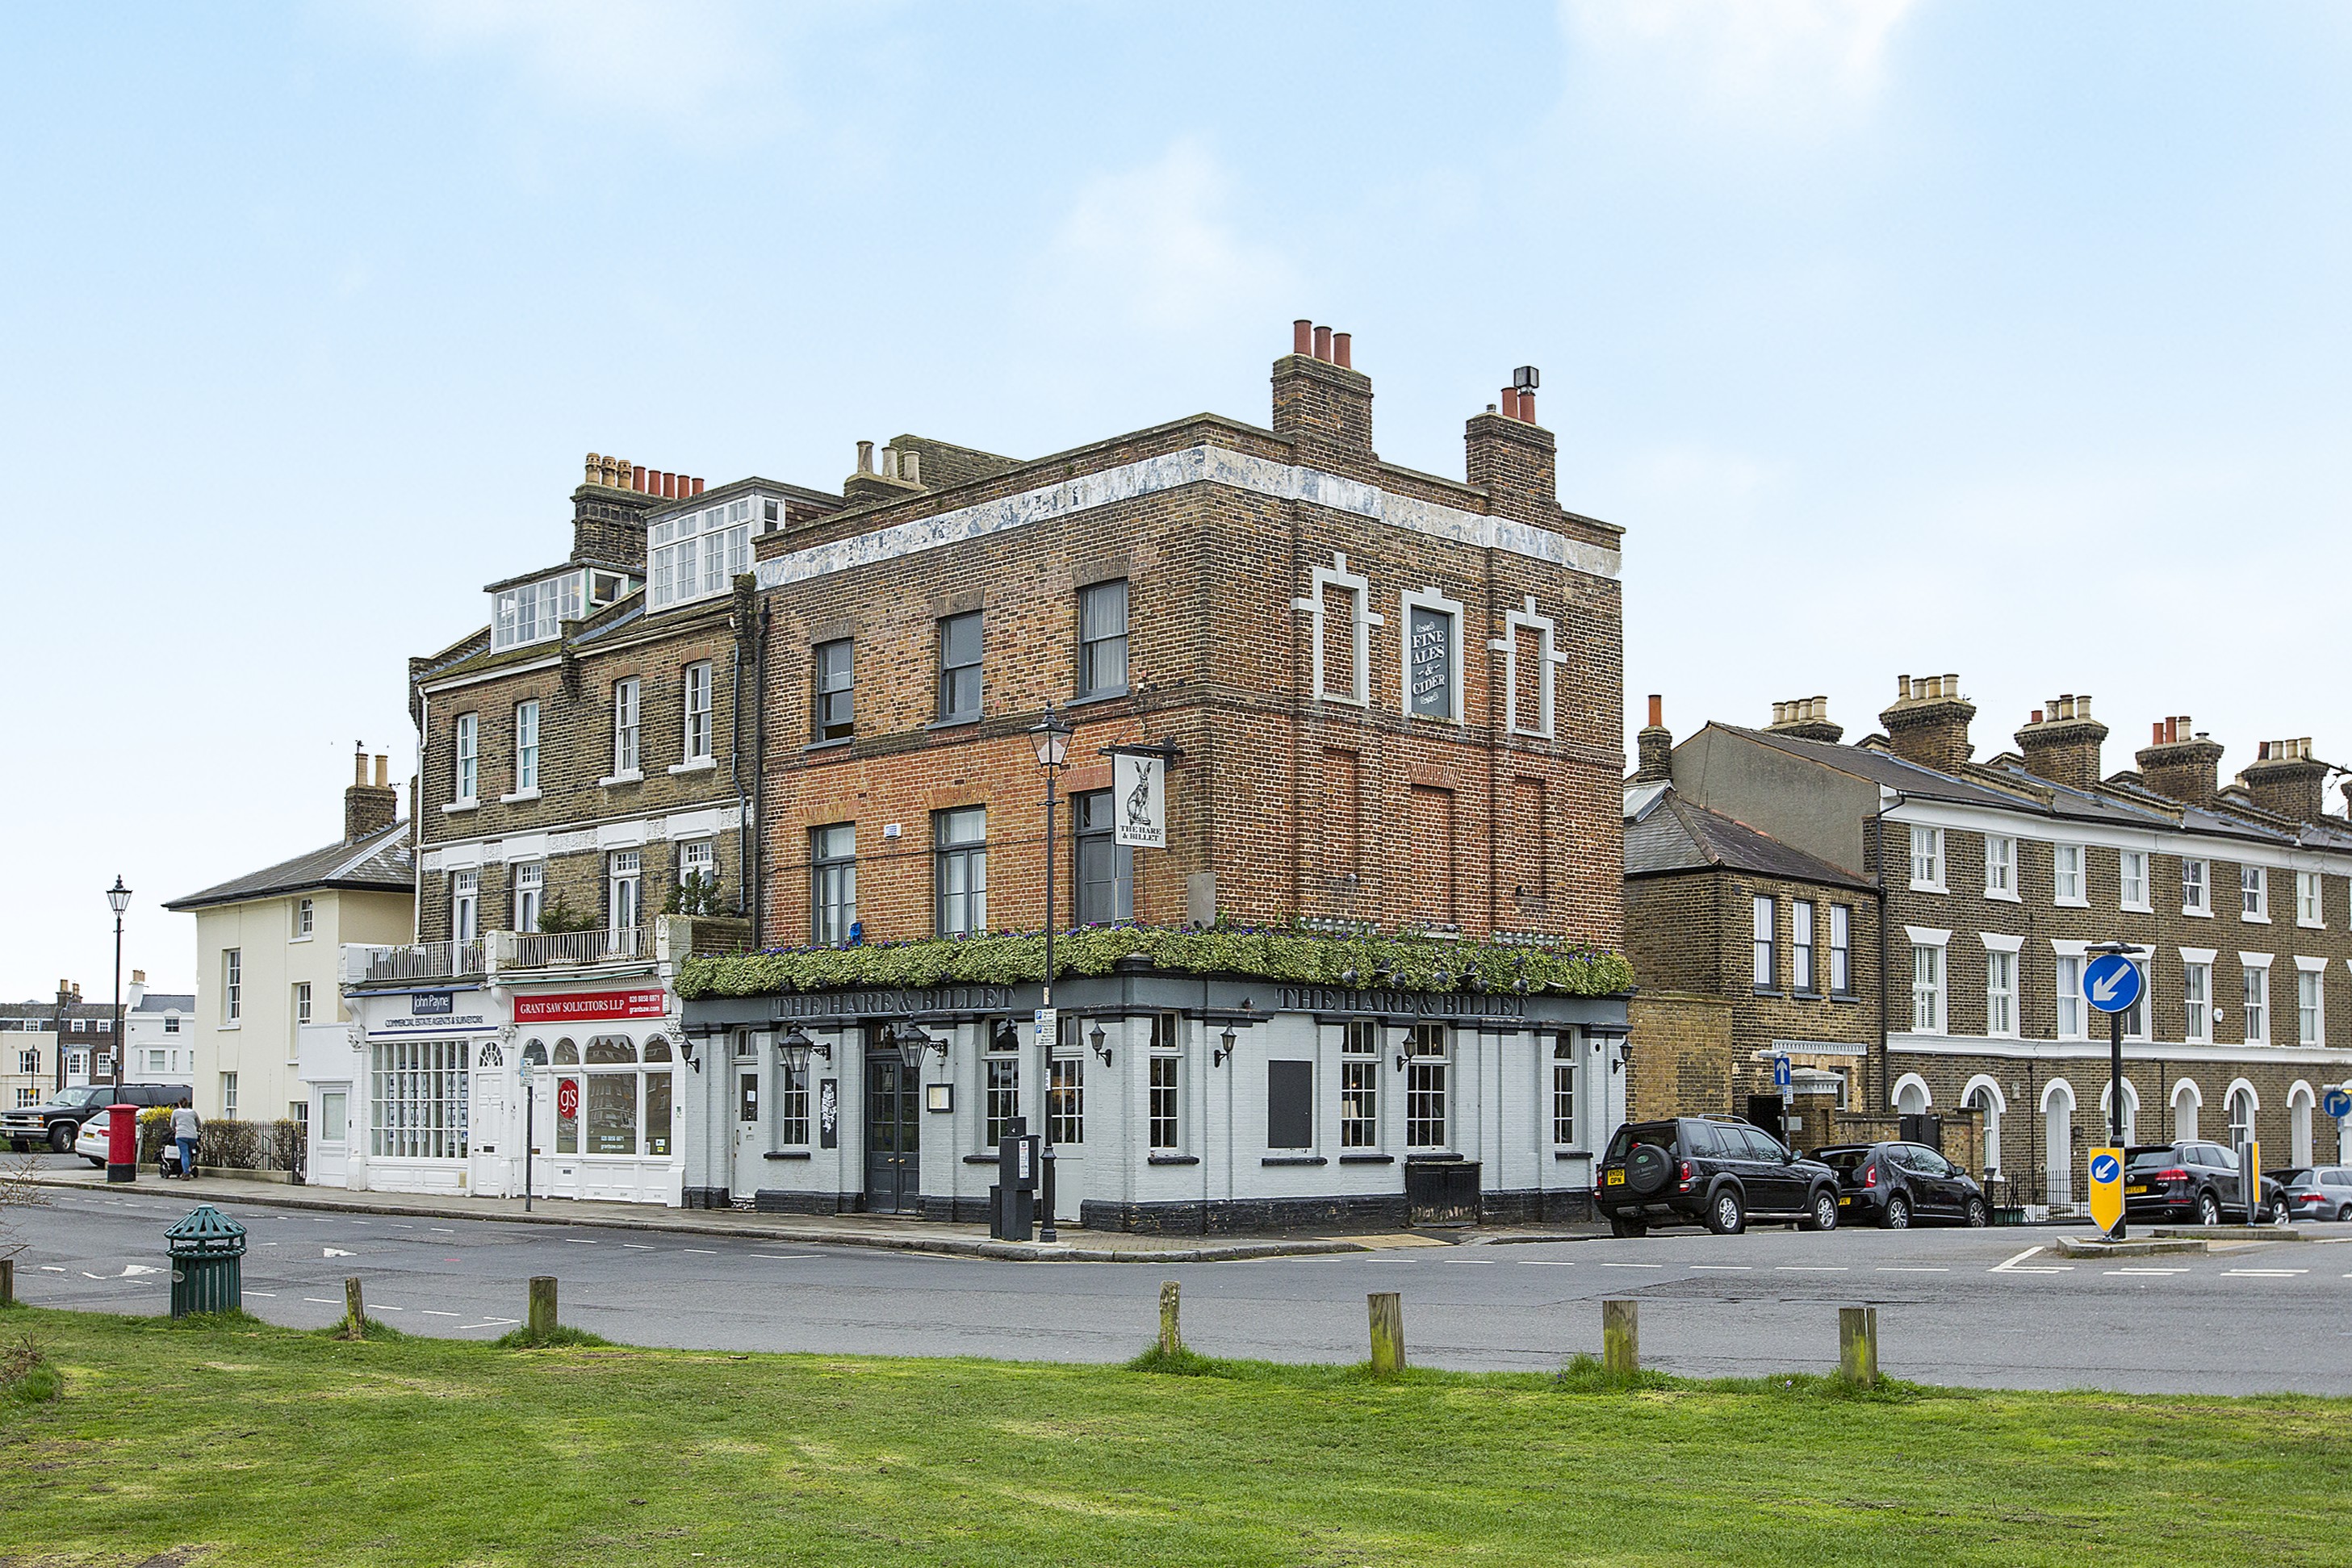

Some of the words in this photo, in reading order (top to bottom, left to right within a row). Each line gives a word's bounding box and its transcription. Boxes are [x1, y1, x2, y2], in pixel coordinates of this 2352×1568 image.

[1412, 630, 1445, 648] FINE
[1412, 645, 1445, 664] ALES
[1412, 674, 1445, 695] CIDER
[1120, 825, 1137, 833] THE
[1139, 826, 1161, 834] HARE
[1129, 833, 1159, 841] BILLET
[429, 994, 449, 1010] Payne
[520, 1002, 546, 1014] GRANT
[546, 1001, 562, 1013] SAW
[563, 1000, 609, 1012] SOLICITORS
[609, 999, 625, 1010] LLP
[772, 996, 822, 1019] THE
[827, 993, 894, 1016] HARE
[898, 991, 915, 1014] &
[919, 988, 1016, 1013] BILLET
[1275, 988, 1336, 1011] THE
[1341, 989, 1415, 1015] HARE
[1419, 994, 1435, 1015] &
[1440, 995, 1530, 1018] BILLET
[560, 1089, 577, 1112] gs
